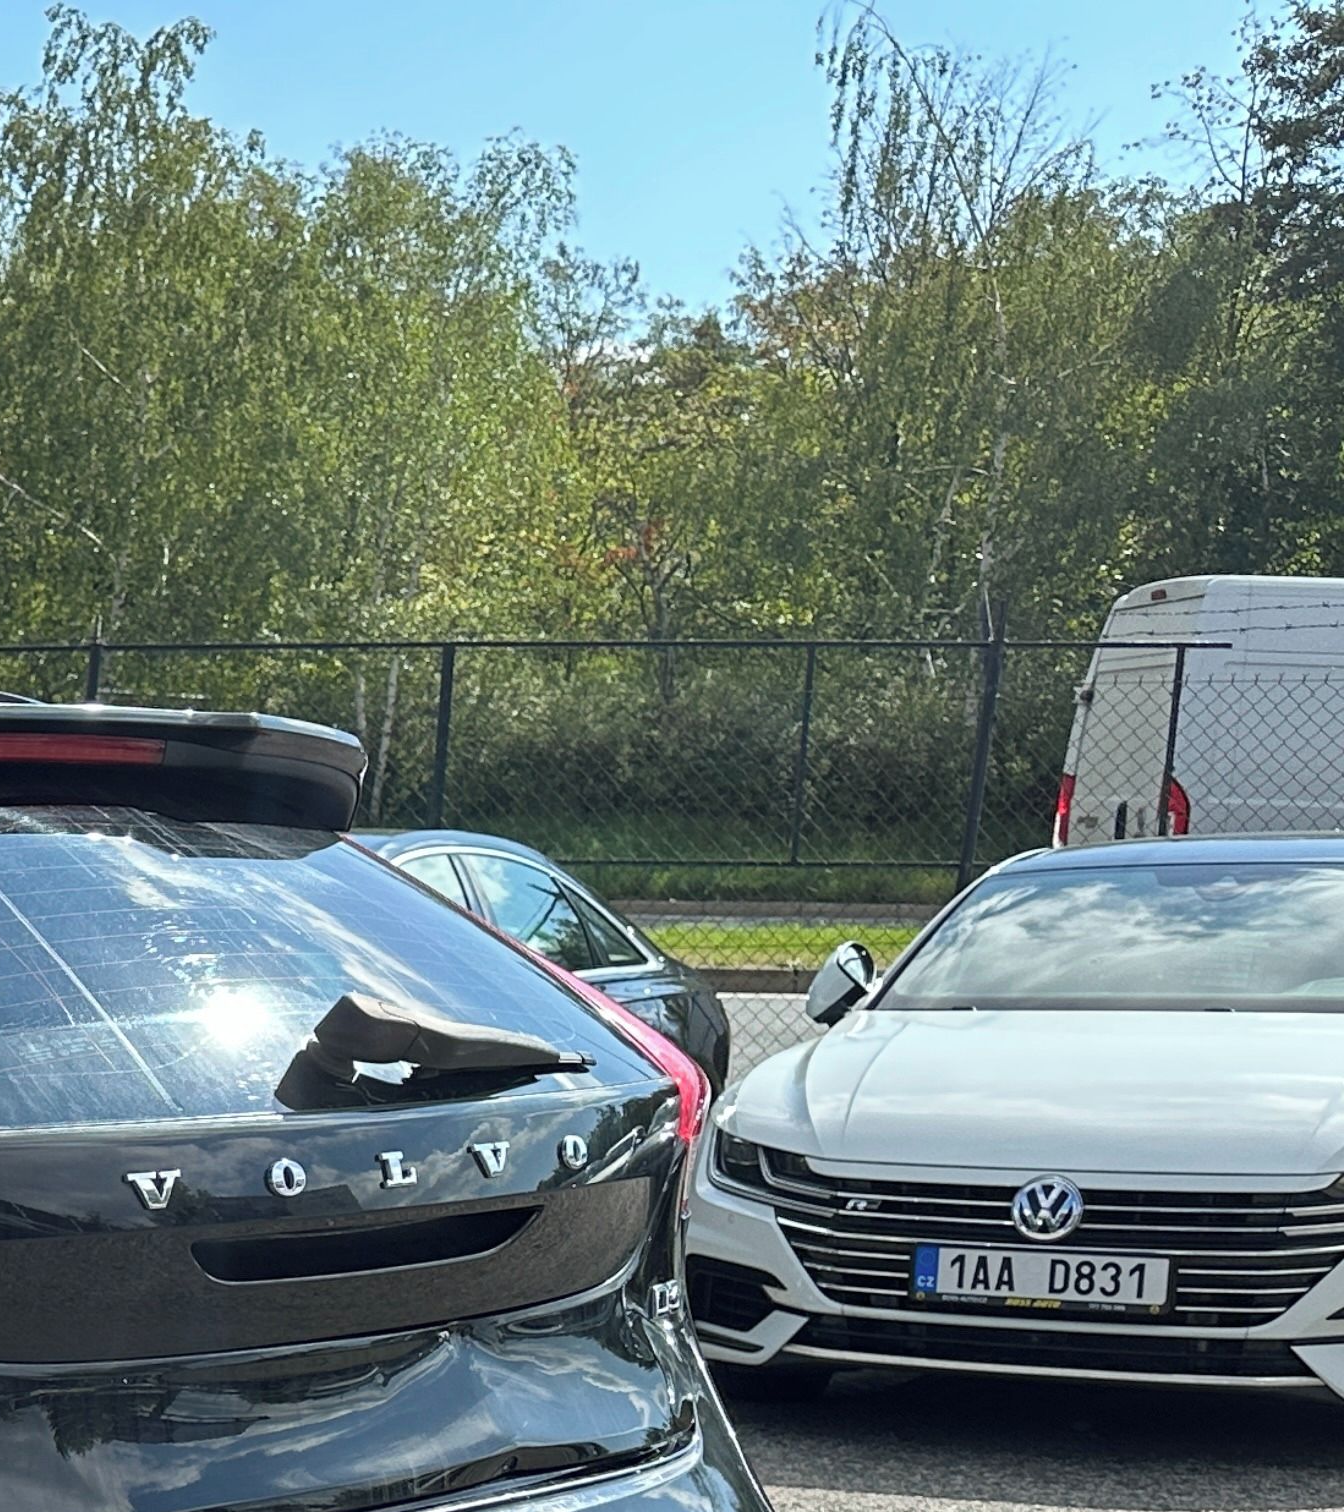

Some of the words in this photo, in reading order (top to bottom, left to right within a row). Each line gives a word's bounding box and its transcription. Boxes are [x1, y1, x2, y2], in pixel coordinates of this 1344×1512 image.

[123, 1134, 589, 1211] VOLVO
[916, 1274, 935, 1288] CZ
[949, 1253, 1016, 1292] 1AA
[1047, 1258, 1147, 1300] D831
